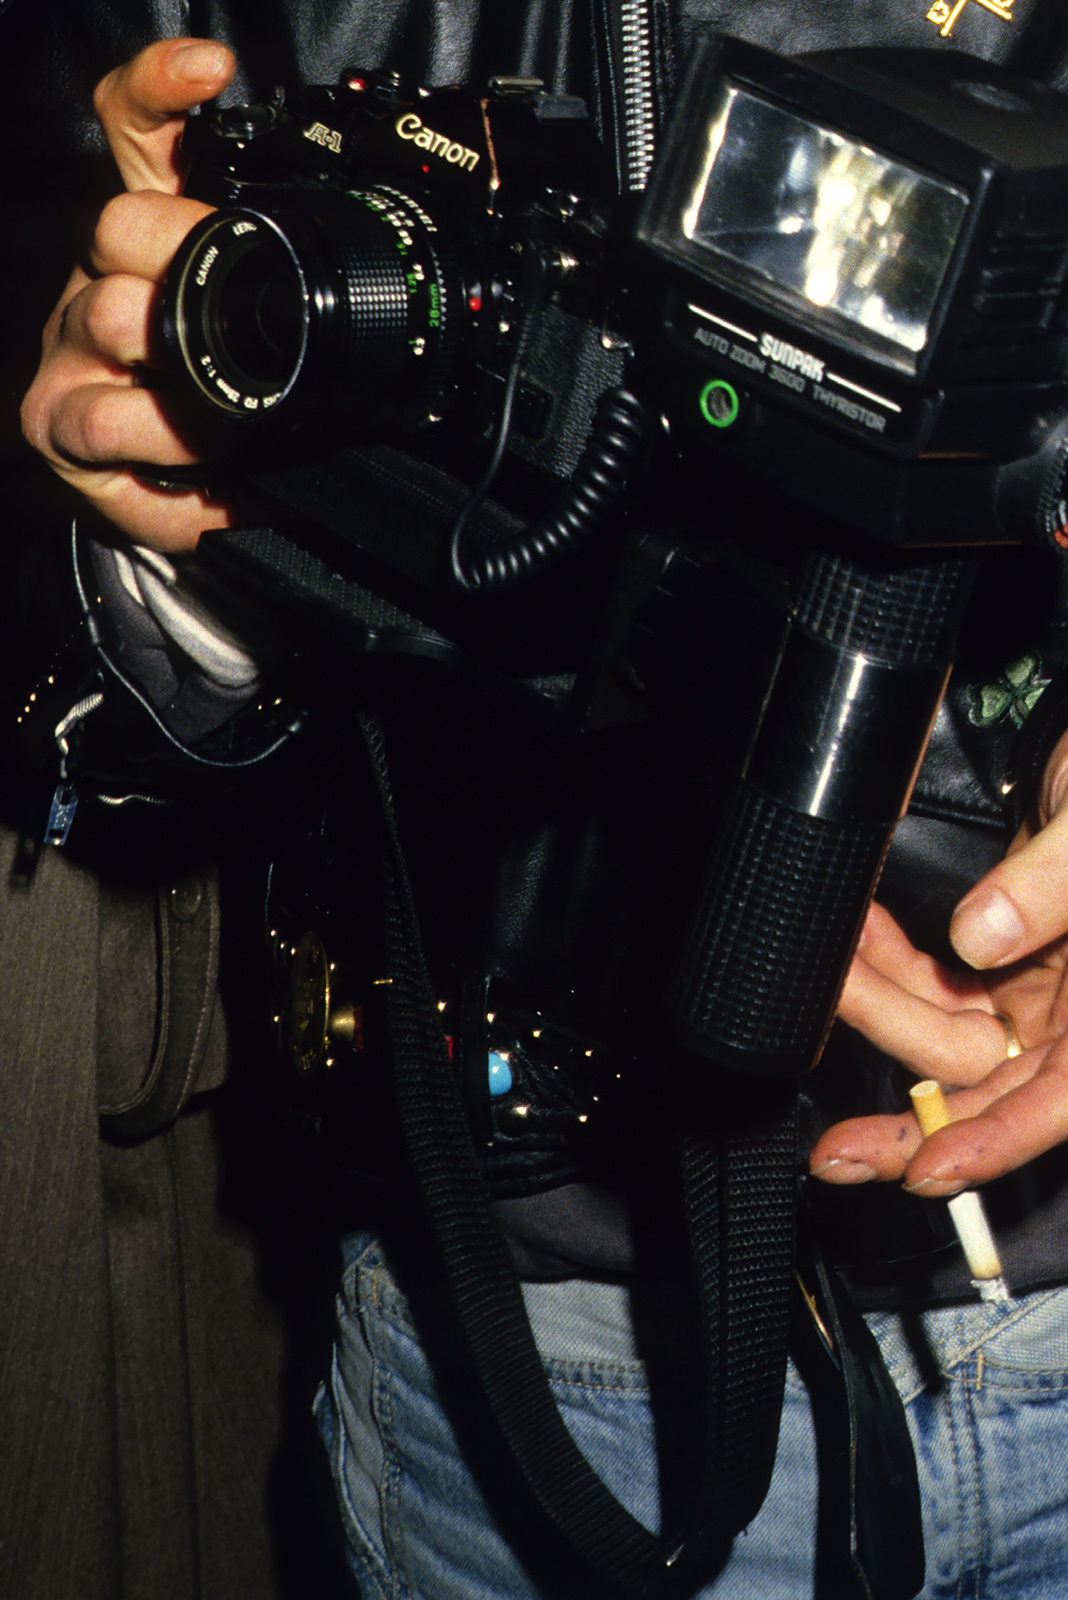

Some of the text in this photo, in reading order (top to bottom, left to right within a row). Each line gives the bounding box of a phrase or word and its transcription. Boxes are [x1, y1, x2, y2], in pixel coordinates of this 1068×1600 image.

[302, 120, 342, 154] A-1
[395, 112, 481, 173] Canon
[195, 245, 219, 286] CANON
[428, 282, 441, 328] 28mm
[200, 354, 217, 379] 1:2
[758, 330, 826, 384] SUNPAK
[693, 326, 888, 433] AUTO ZOOM 3600 THYRISTOR
[243, 394, 259, 410] FD
